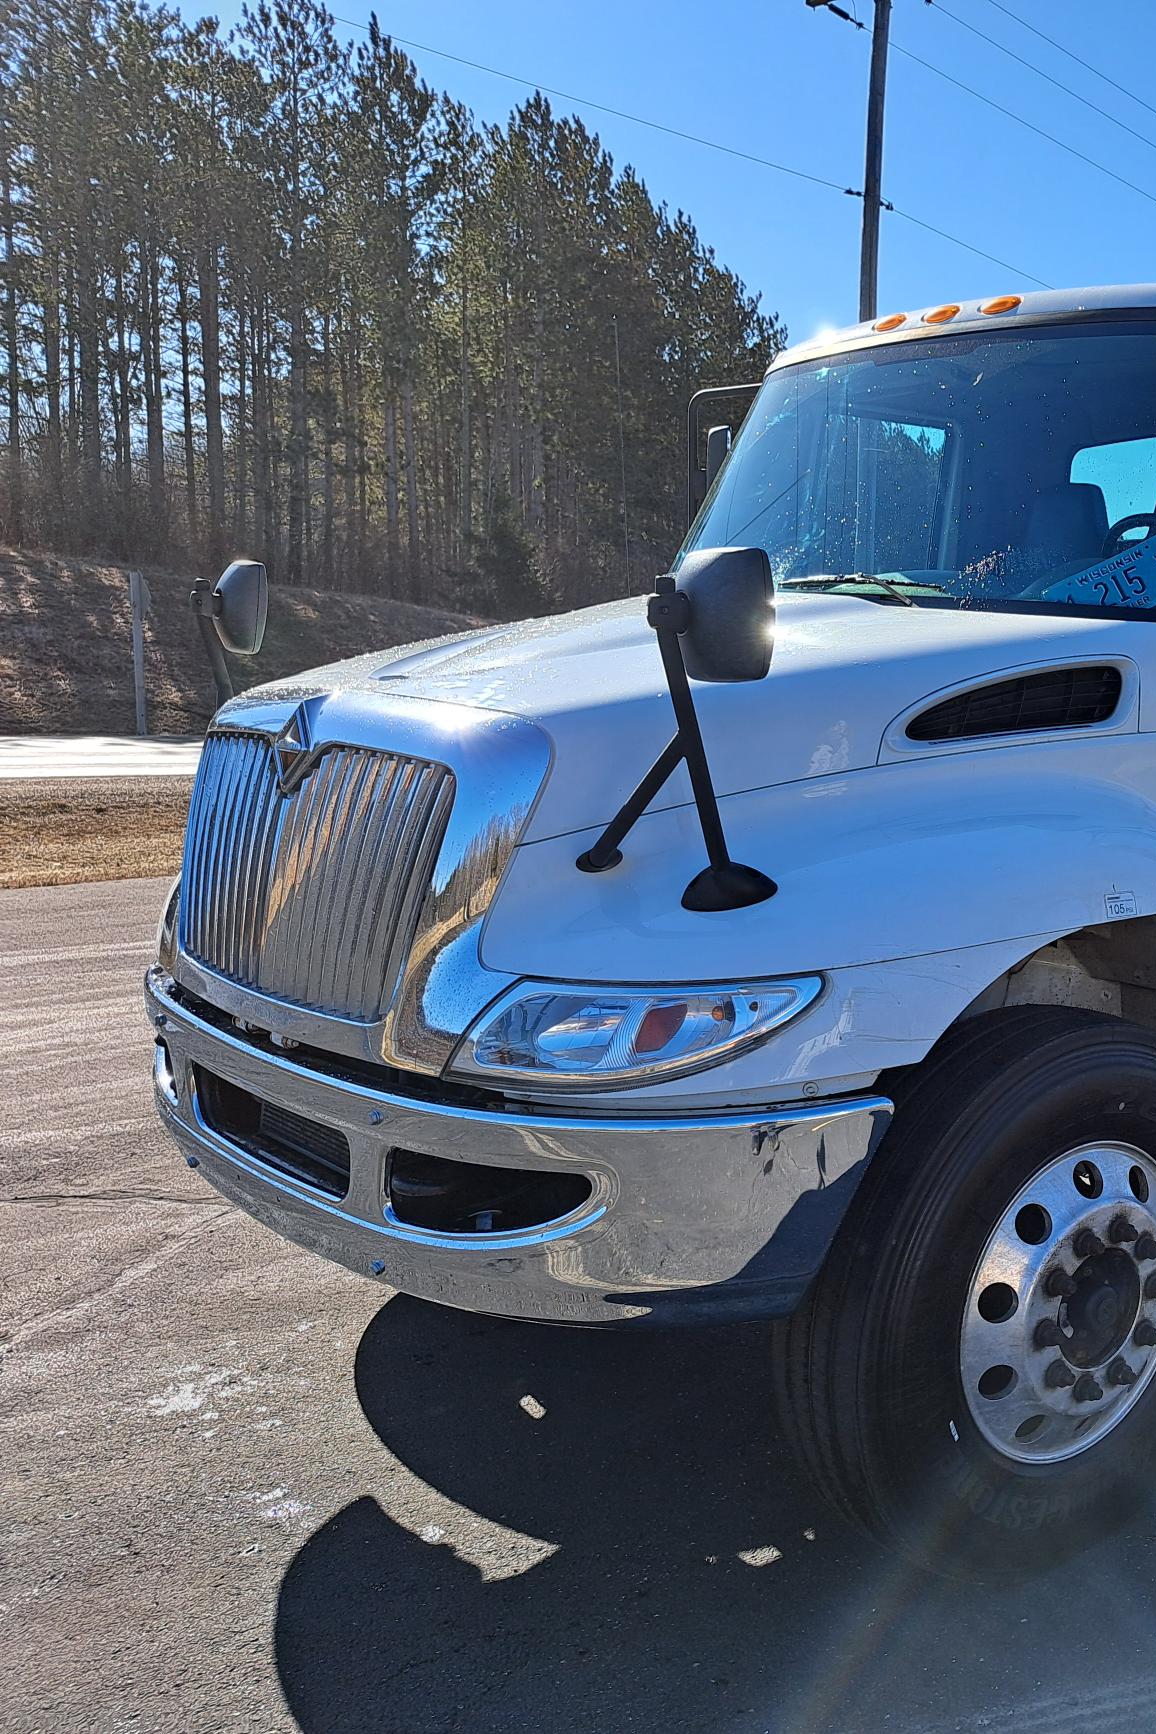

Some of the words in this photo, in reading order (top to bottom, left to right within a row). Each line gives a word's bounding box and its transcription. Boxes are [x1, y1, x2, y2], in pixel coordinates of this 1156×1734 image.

[1075, 549, 1144, 587] WISCONSIN
[1092, 565, 1146, 606] 215
[1108, 903, 1125, 915] 105
